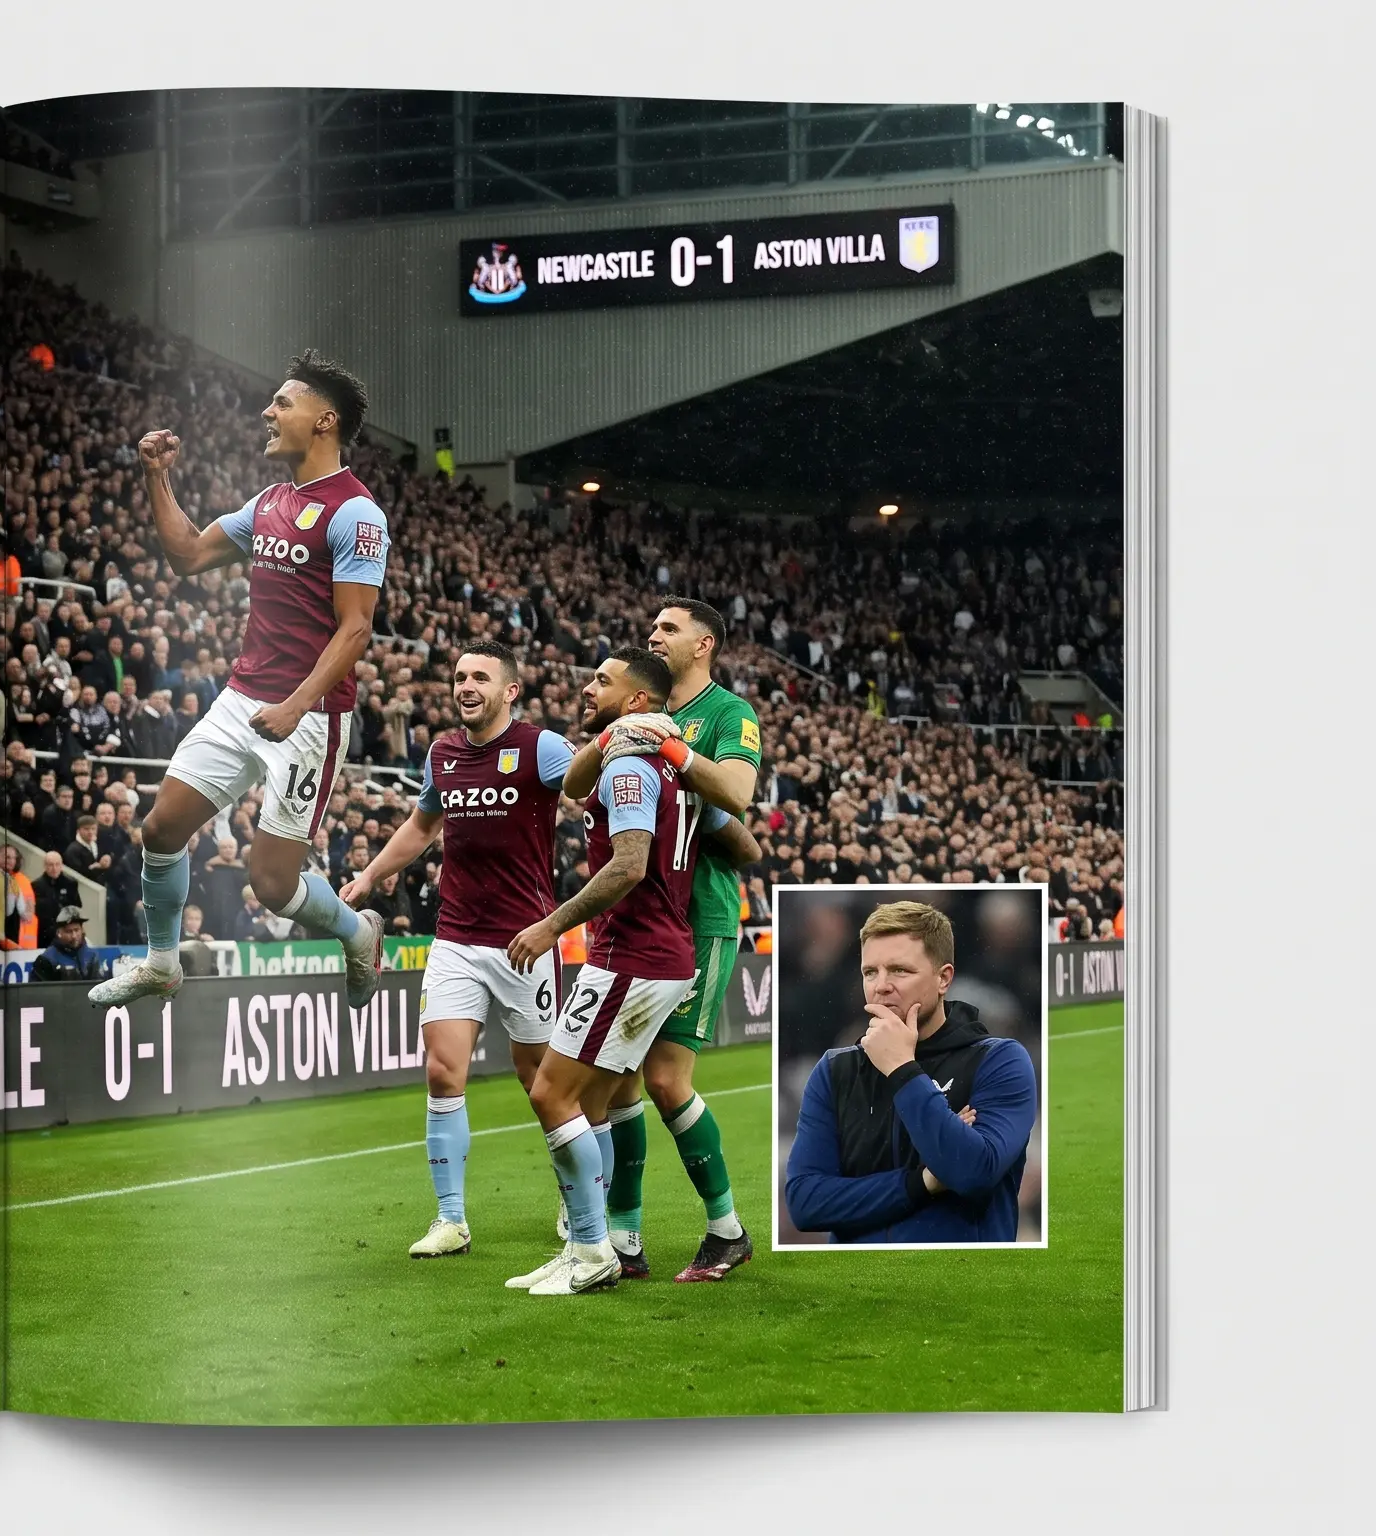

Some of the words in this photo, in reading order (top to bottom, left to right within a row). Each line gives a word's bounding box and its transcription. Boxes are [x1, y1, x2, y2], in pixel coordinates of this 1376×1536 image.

[538, 250, 654, 284] NEWCASTLE
[670, 235, 734, 287] 0-1
[754, 237, 822, 270] ASTON
[826, 234, 886, 265] VILLA
[252, 534, 309, 564] AZOO
[285, 763, 317, 802] 16
[441, 787, 518, 808] CAZOO
[536, 978, 552, 1011] 6
[564, 984, 599, 1023] 12
[105, 1001, 172, 1101] 0-1
[222, 991, 338, 1087] ASTON
